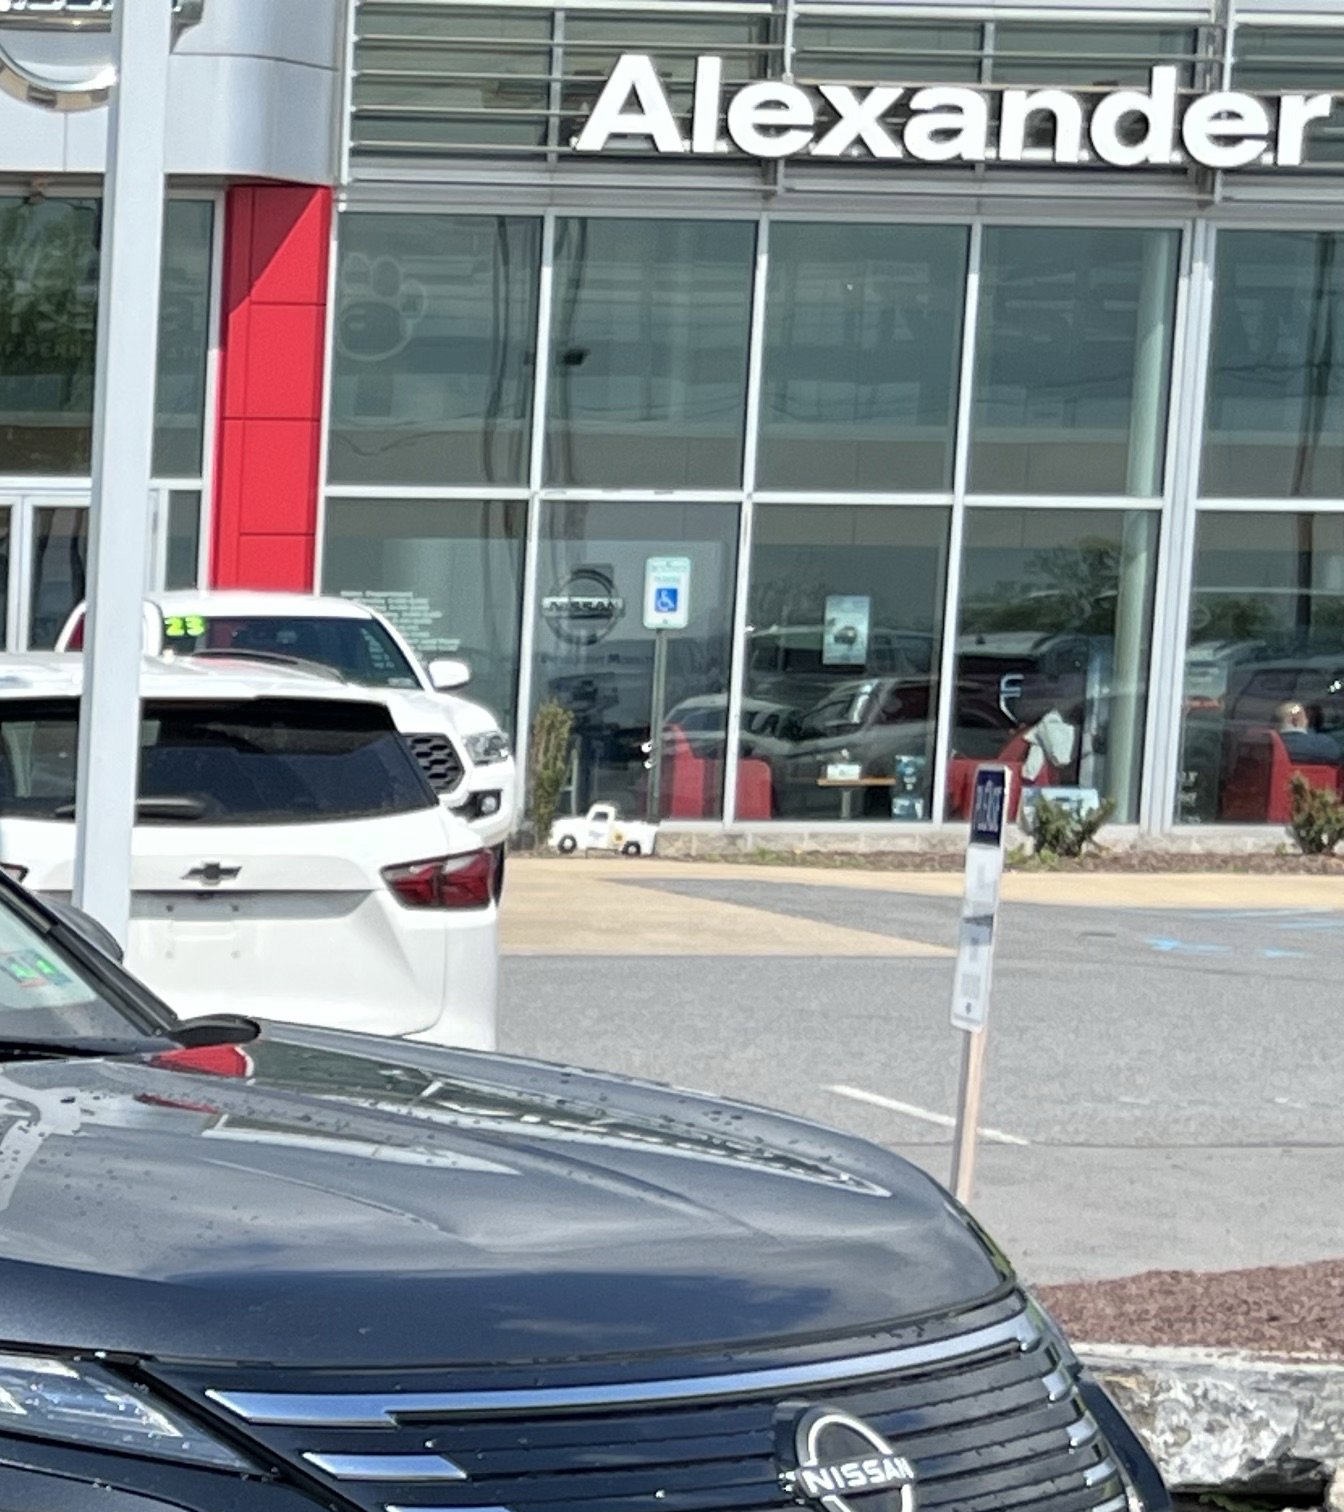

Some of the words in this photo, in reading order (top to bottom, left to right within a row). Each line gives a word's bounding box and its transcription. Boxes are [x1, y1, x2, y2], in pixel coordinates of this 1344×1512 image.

[574, 53, 1331, 167] Alexander
[164, 614, 206, 637] 23
[801, 1456, 914, 1494] NISSAN
